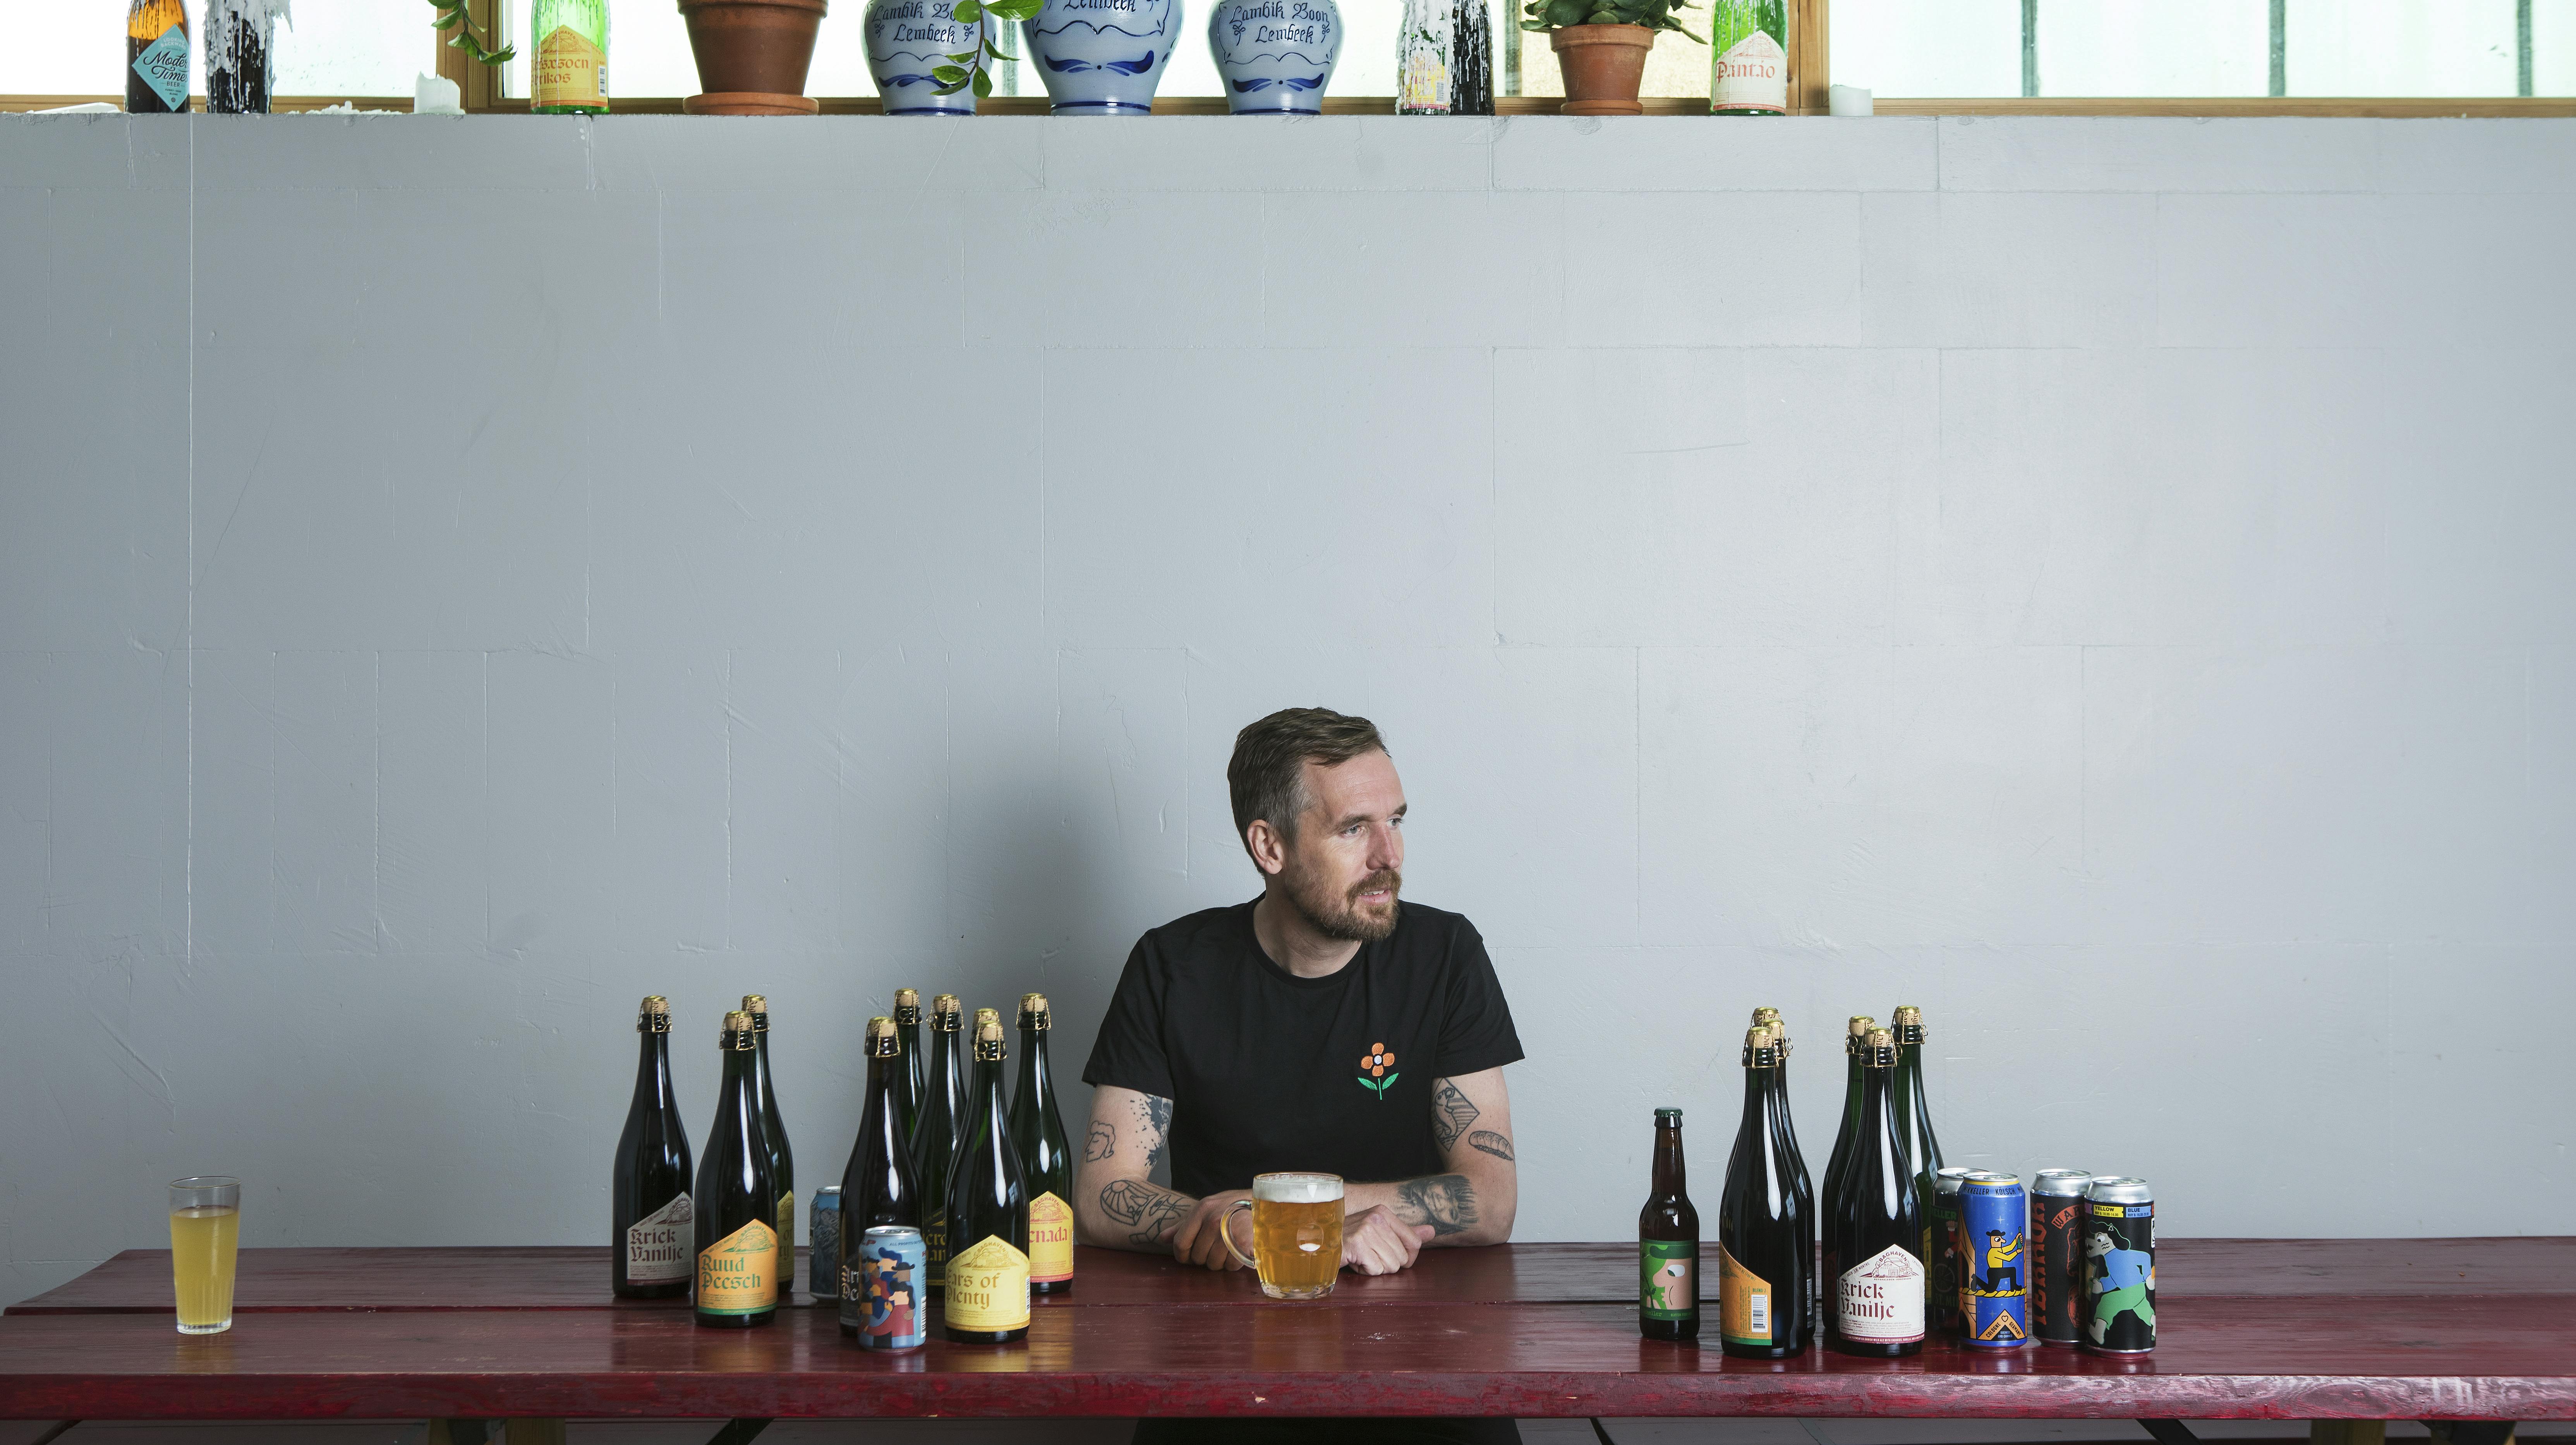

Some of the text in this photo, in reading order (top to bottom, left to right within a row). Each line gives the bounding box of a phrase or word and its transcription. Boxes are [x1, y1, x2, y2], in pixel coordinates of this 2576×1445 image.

[1229, 1, 1329, 24] Lambik Boon
[893, 24, 956, 44] Lembeek
[1255, 24, 1314, 44] Lembeek
[143, 50, 189, 69] Moder
[1995, 1187, 2016, 1195] KÖLSCH
[1879, 1251, 1907, 1262] BAGHAVEN
[980, 1273, 1001, 1288] of
[1986, 1322, 2001, 1338] COLOGNE
[2009, 1321, 2021, 1336] GERMANY
